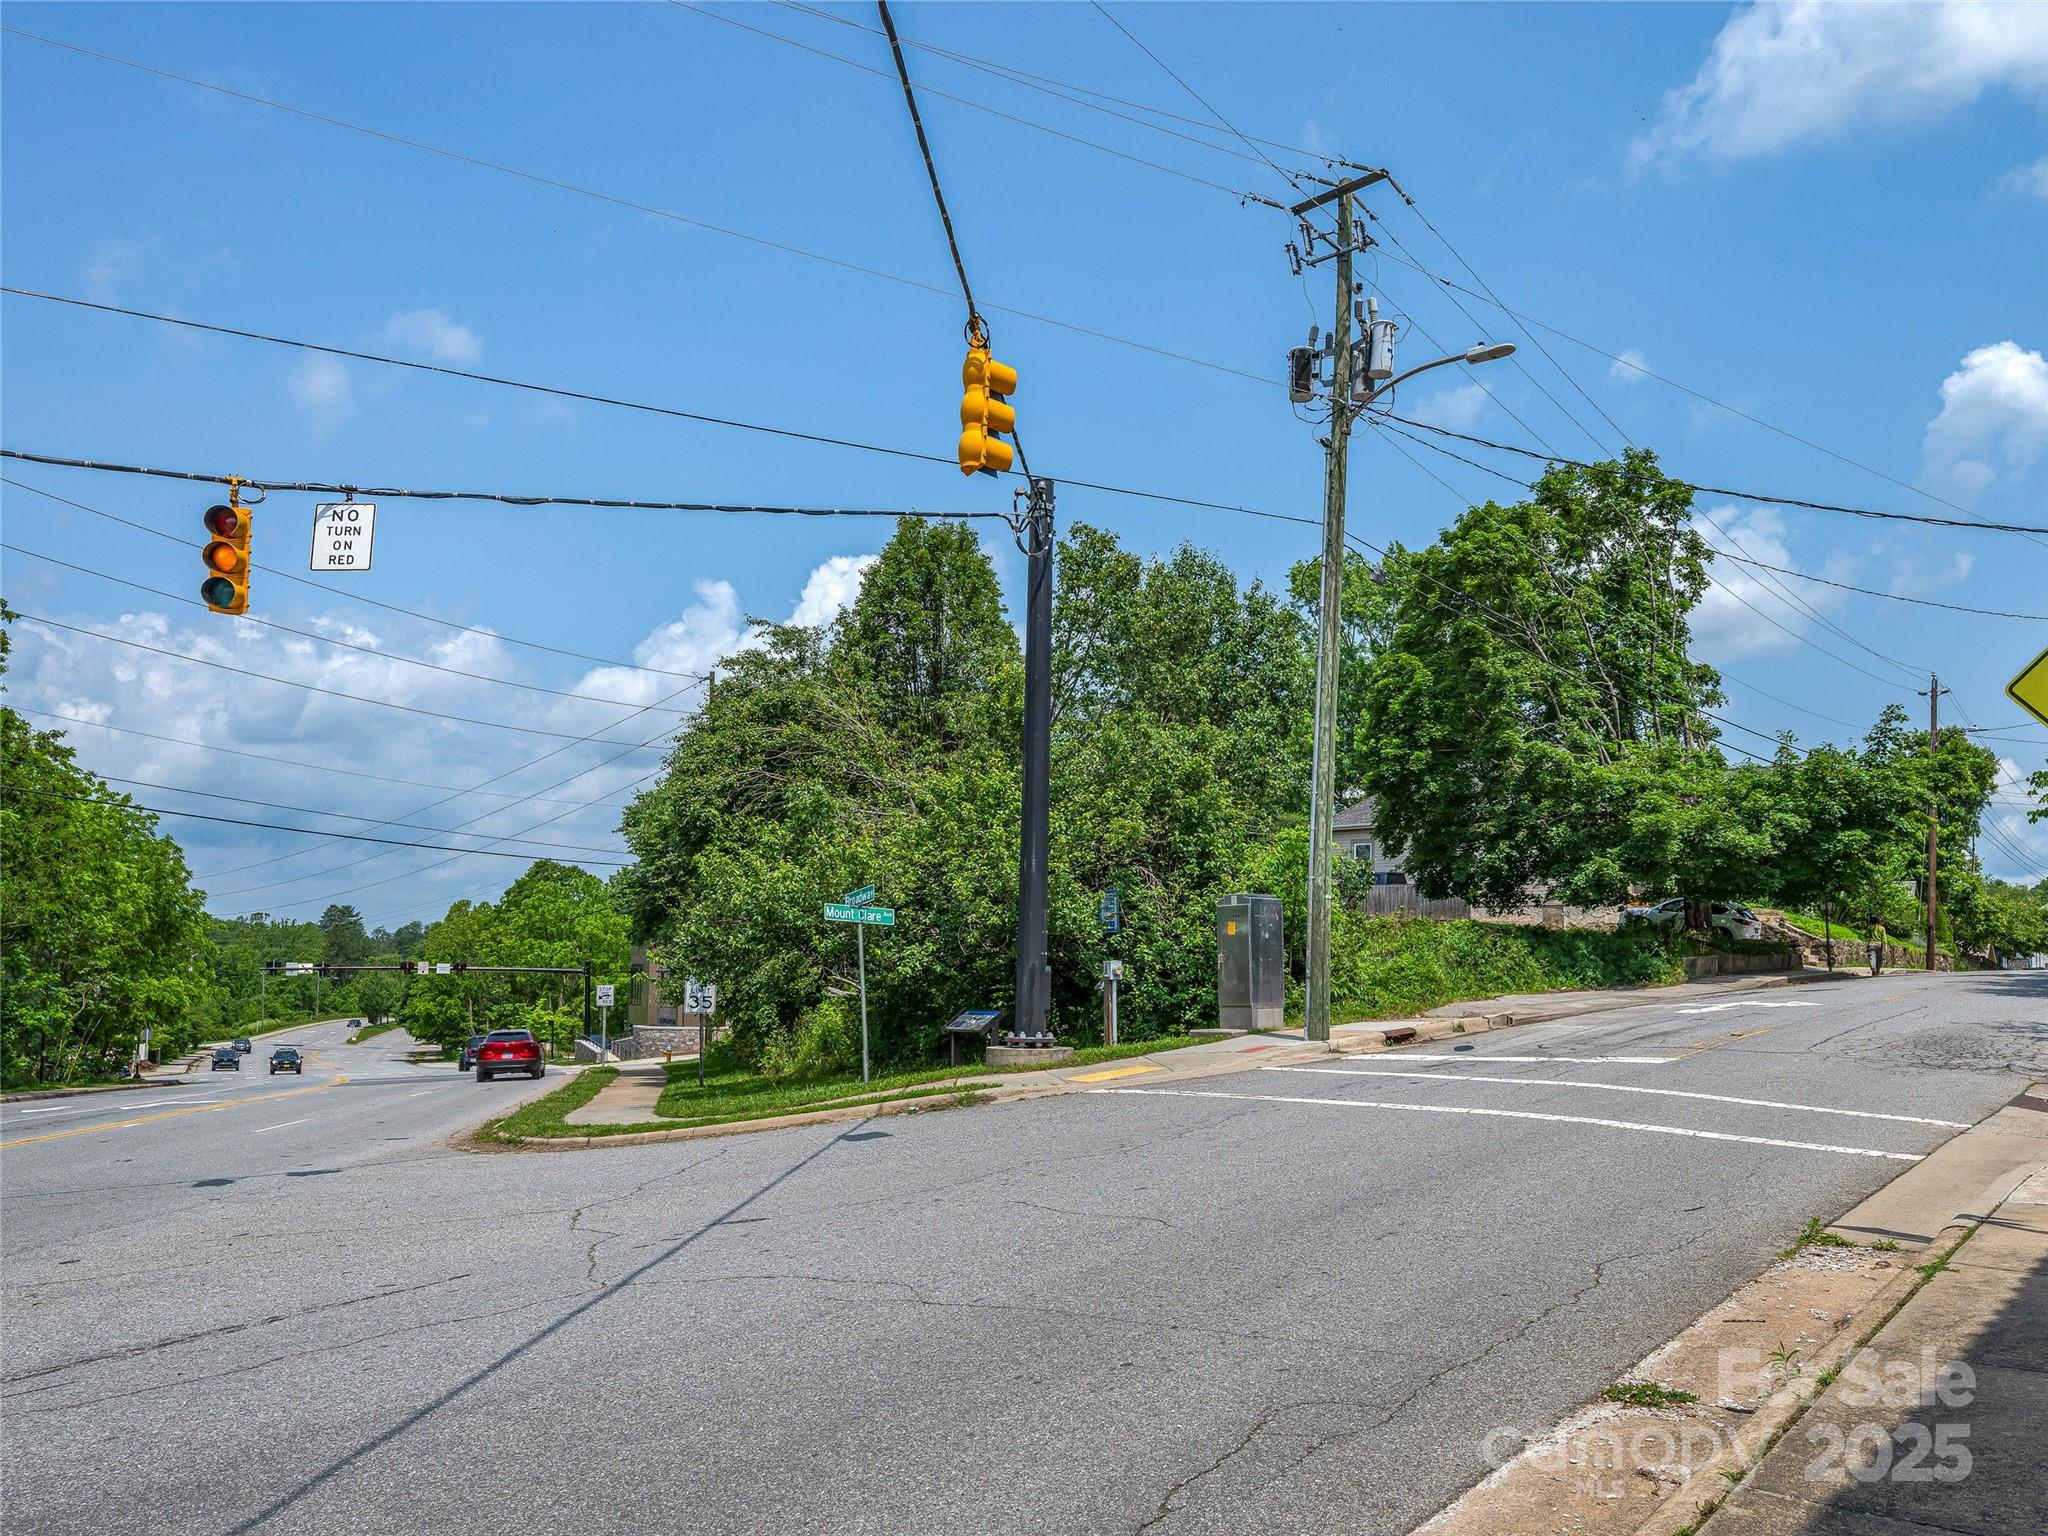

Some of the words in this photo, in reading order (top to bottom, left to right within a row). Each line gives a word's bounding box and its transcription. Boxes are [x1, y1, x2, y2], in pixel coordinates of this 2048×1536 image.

[332, 510, 359, 521] NO
[327, 526, 361, 536] TURN
[333, 540, 352, 550] ON
[328, 555, 354, 565] RED
[827, 906, 854, 919] Mount
[858, 909, 881, 921] Clare
[689, 995, 712, 1008] 35
